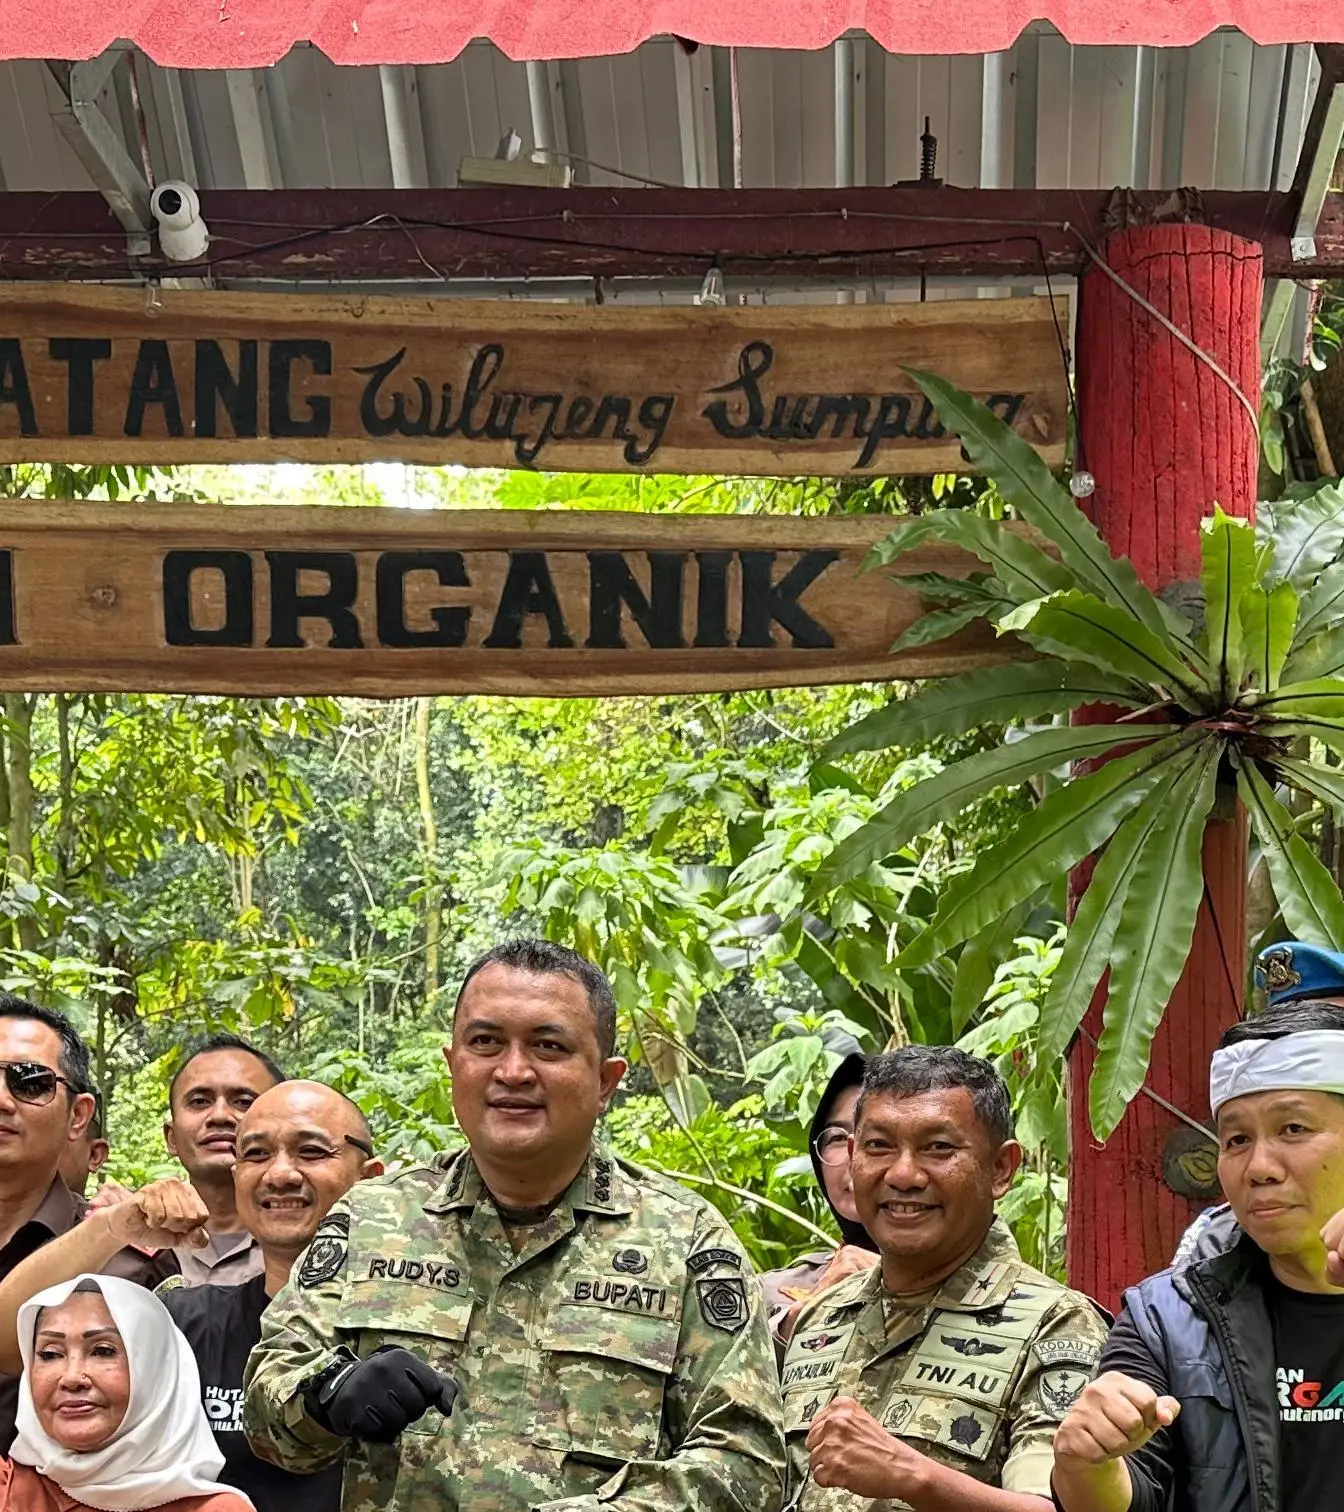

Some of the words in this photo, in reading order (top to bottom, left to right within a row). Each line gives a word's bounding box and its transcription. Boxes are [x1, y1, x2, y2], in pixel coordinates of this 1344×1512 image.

[163, 549, 841, 650] ORGANIK
[369, 1258, 460, 1287] RUDY.S
[574, 1280, 667, 1311] BUPATI
[916, 1362, 957, 1385] TNI
[958, 1371, 999, 1394] AU
